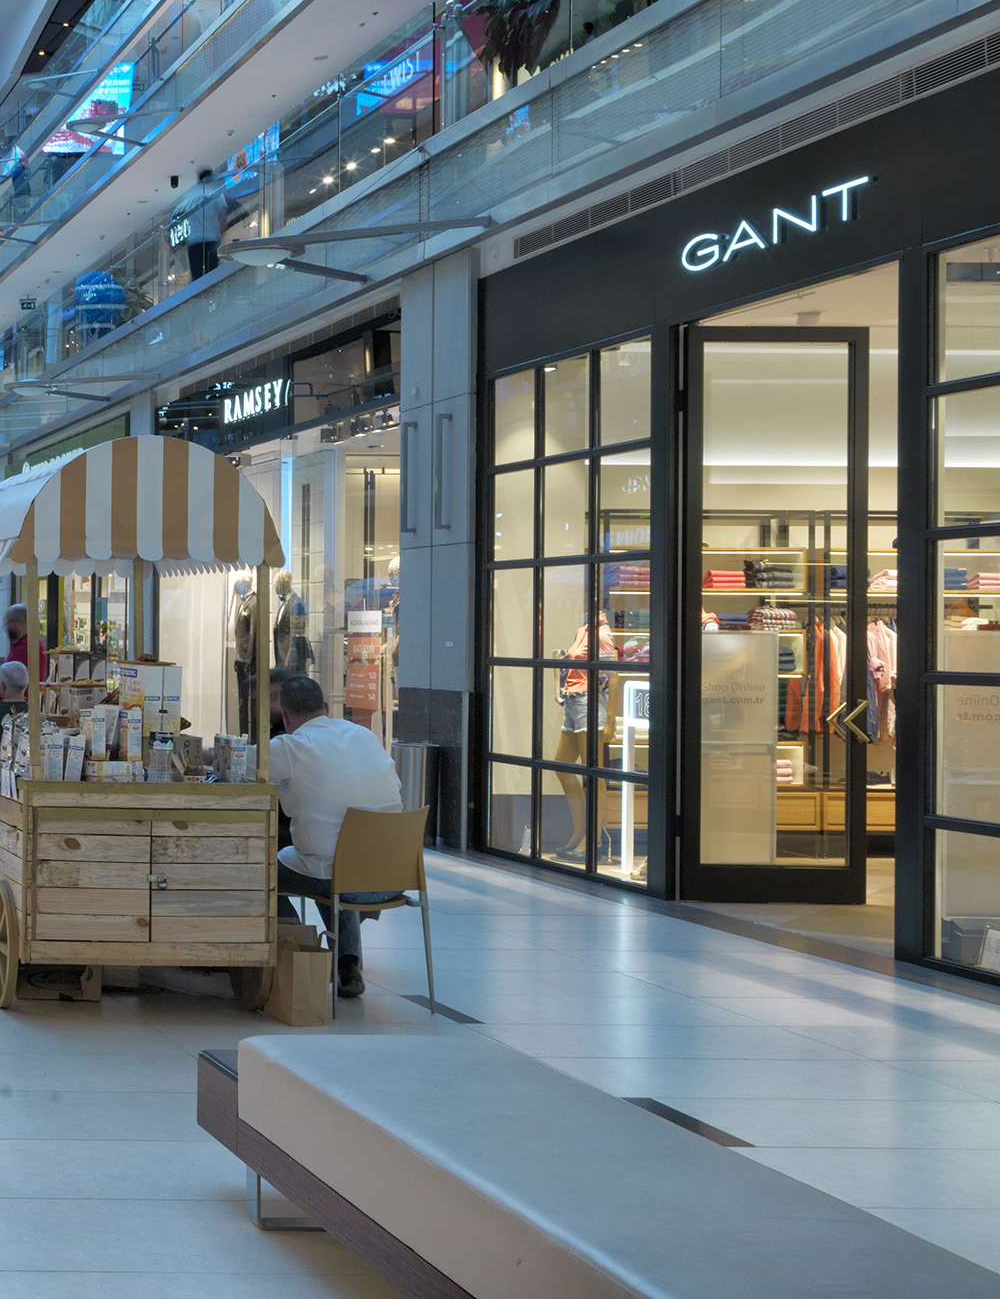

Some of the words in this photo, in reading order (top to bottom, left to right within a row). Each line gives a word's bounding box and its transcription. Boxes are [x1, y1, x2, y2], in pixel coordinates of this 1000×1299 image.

[681, 175, 870, 272] GANT
[223, 378, 283, 424] RAMSEY
[702, 682, 728, 693] Shop
[730, 682, 766, 692] Online
[702, 696, 765, 706] gant.com.tr
